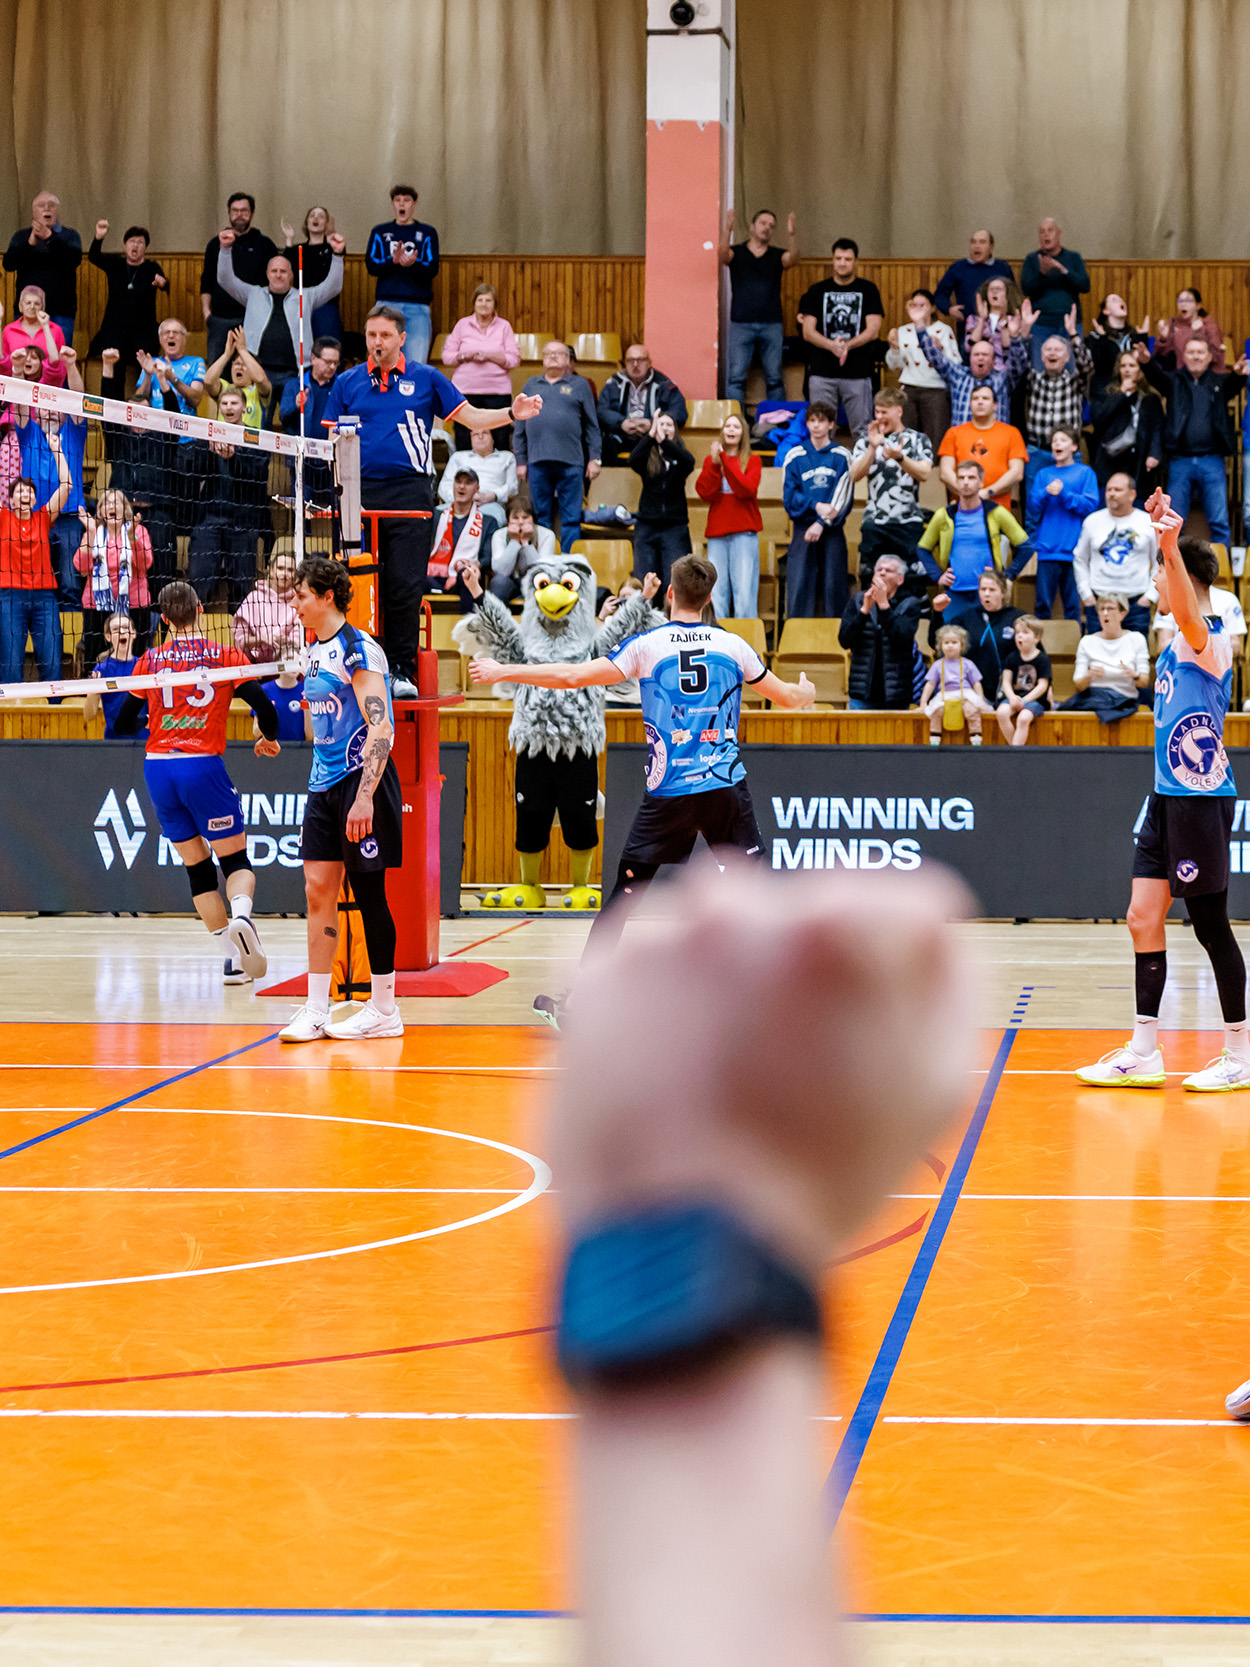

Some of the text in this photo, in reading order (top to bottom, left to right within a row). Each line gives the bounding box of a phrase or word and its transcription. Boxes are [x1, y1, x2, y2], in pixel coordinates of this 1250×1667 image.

[669, 631, 712, 643] ZAJÍČEK
[308, 660, 319, 679] 18
[678, 648, 709, 695] 5
[771, 796, 975, 831] WINNING
[771, 837, 922, 871] MINDS
